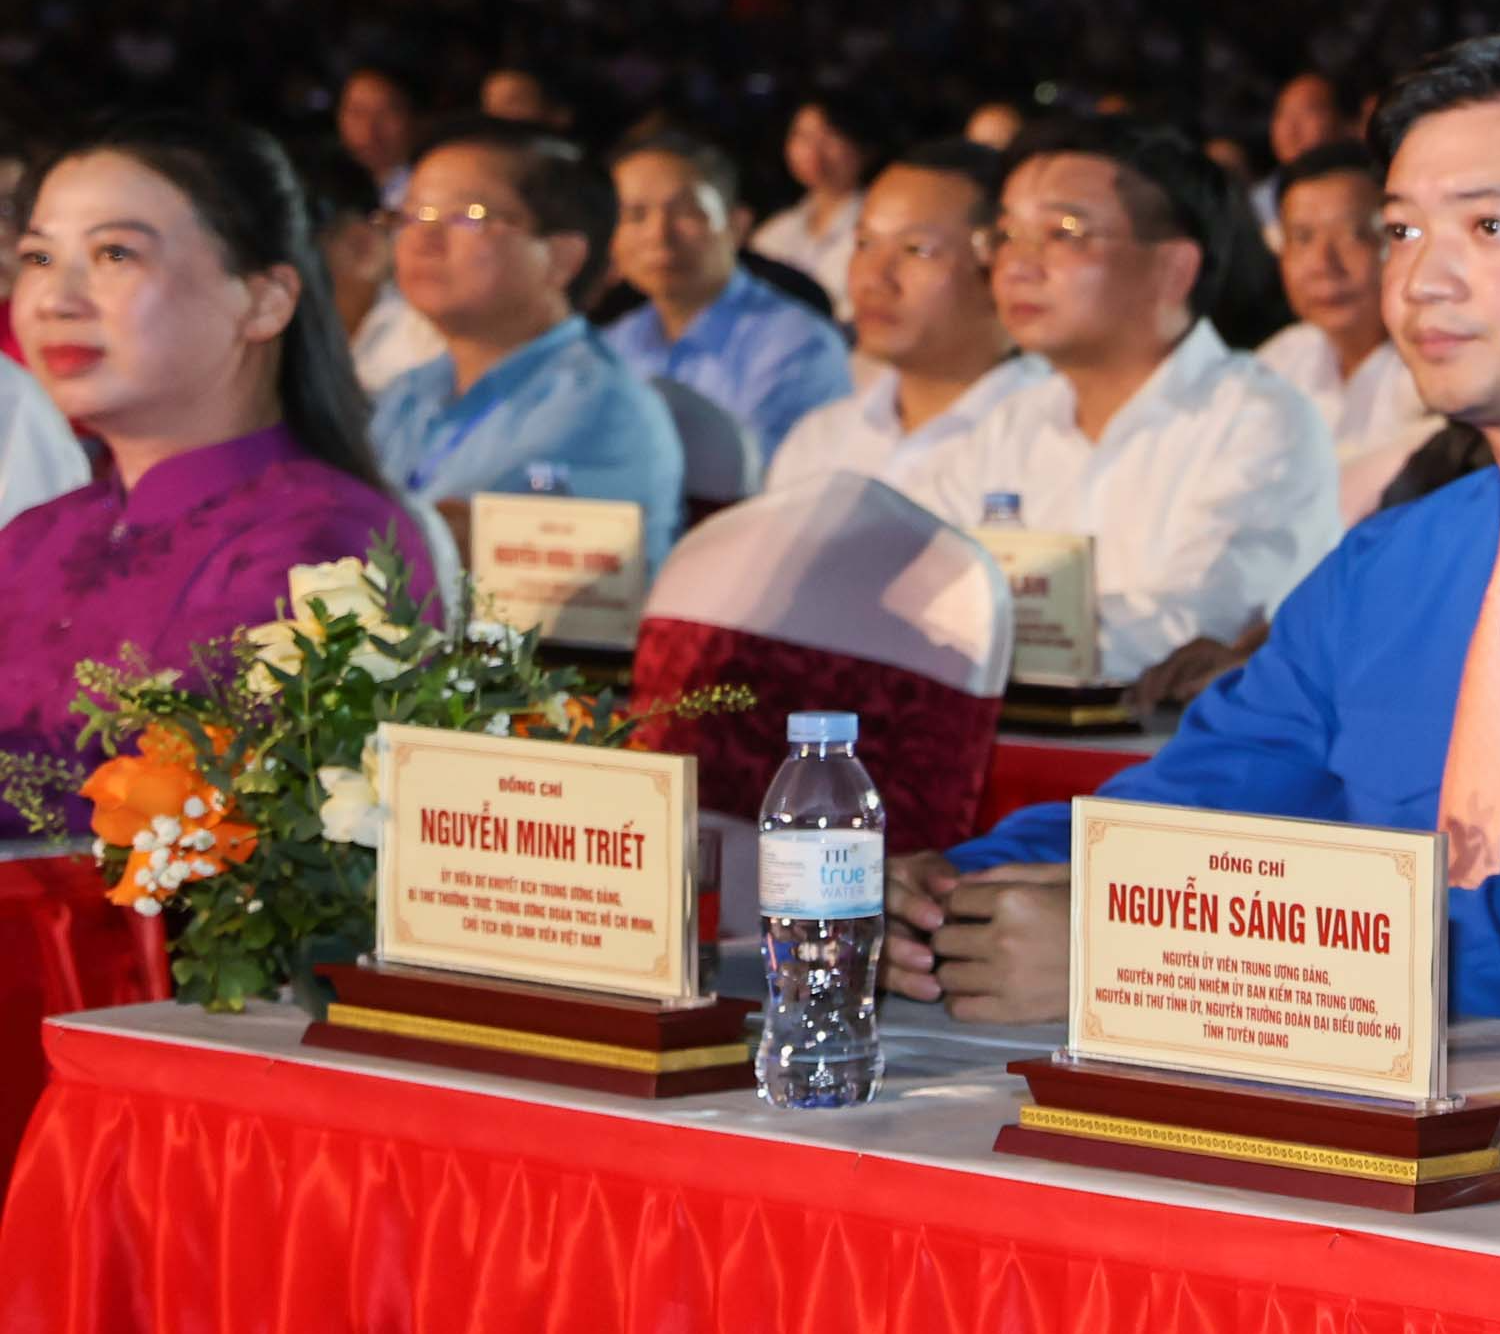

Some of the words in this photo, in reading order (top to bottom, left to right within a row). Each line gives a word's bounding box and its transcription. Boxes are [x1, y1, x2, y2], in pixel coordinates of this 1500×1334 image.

[421, 801, 508, 853] NGUYỄN
[517, 820, 576, 861] MINH
[584, 820, 645, 870] TRIẾT
[821, 864, 865, 884] true
[1209, 852, 1252, 875] ĐỒNG
[1258, 858, 1285, 878] CHÍ
[1109, 876, 1218, 934] NGUYỄN
[1228, 890, 1305, 944] SÁNG
[1316, 906, 1390, 954] VANG
[1247, 983, 1266, 1000] BAN
[1296, 989, 1312, 1005] TRA
[1316, 993, 1346, 1010] TRUNG
[1227, 1026, 1255, 1044] TUYÊN
[1258, 1030, 1288, 1049] QUANG
